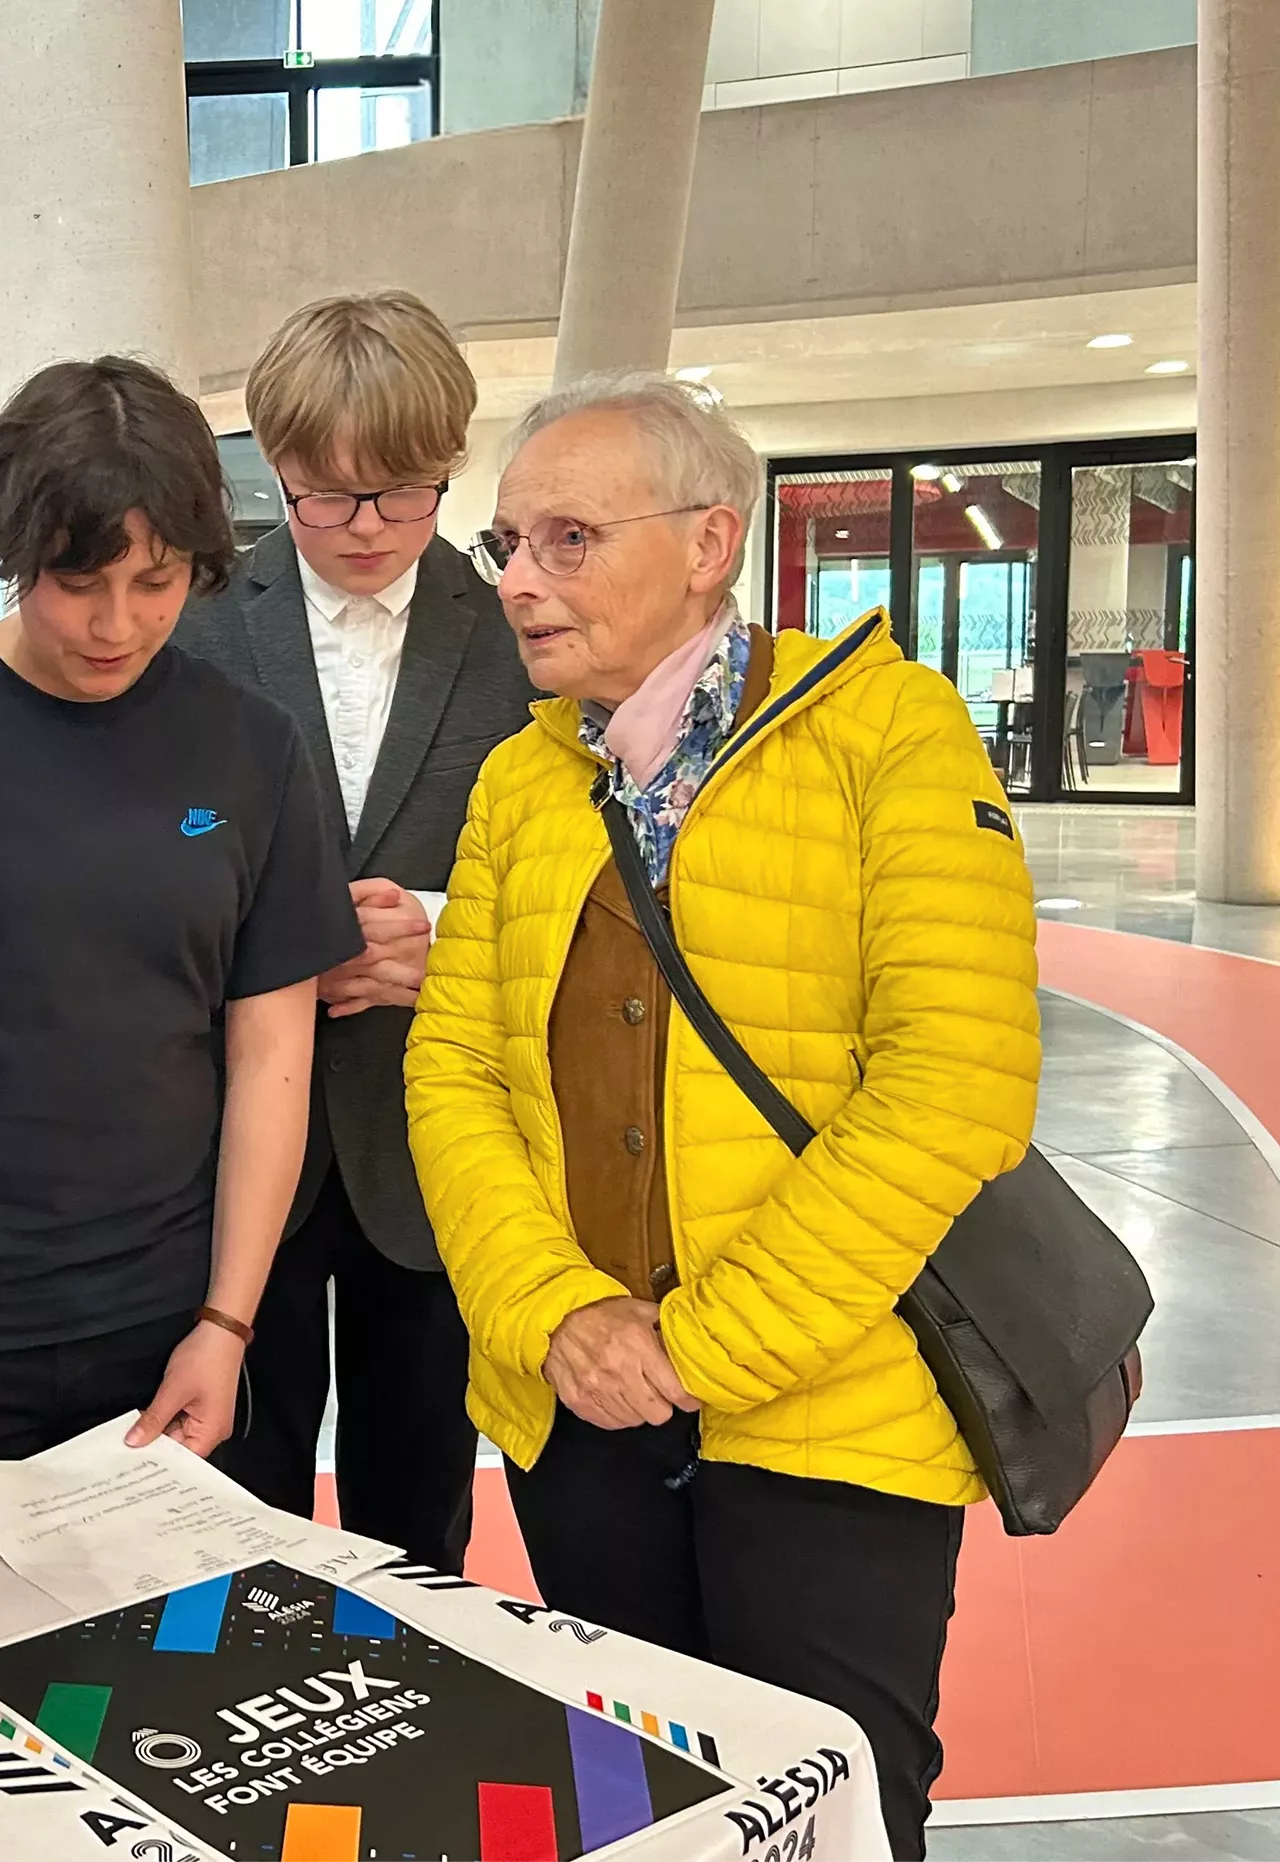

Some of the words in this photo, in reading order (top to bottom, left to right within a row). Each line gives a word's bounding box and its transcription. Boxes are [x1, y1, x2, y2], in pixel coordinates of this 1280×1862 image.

[172, 1761, 240, 1795] LES
[240, 1688, 432, 1768] COLLÉGIENS
[215, 1659, 401, 1744] JEUX
[203, 1767, 303, 1815] FONT
[300, 1720, 426, 1776] ÉQUIPE
[723, 1747, 850, 1857] ALÉSIA
